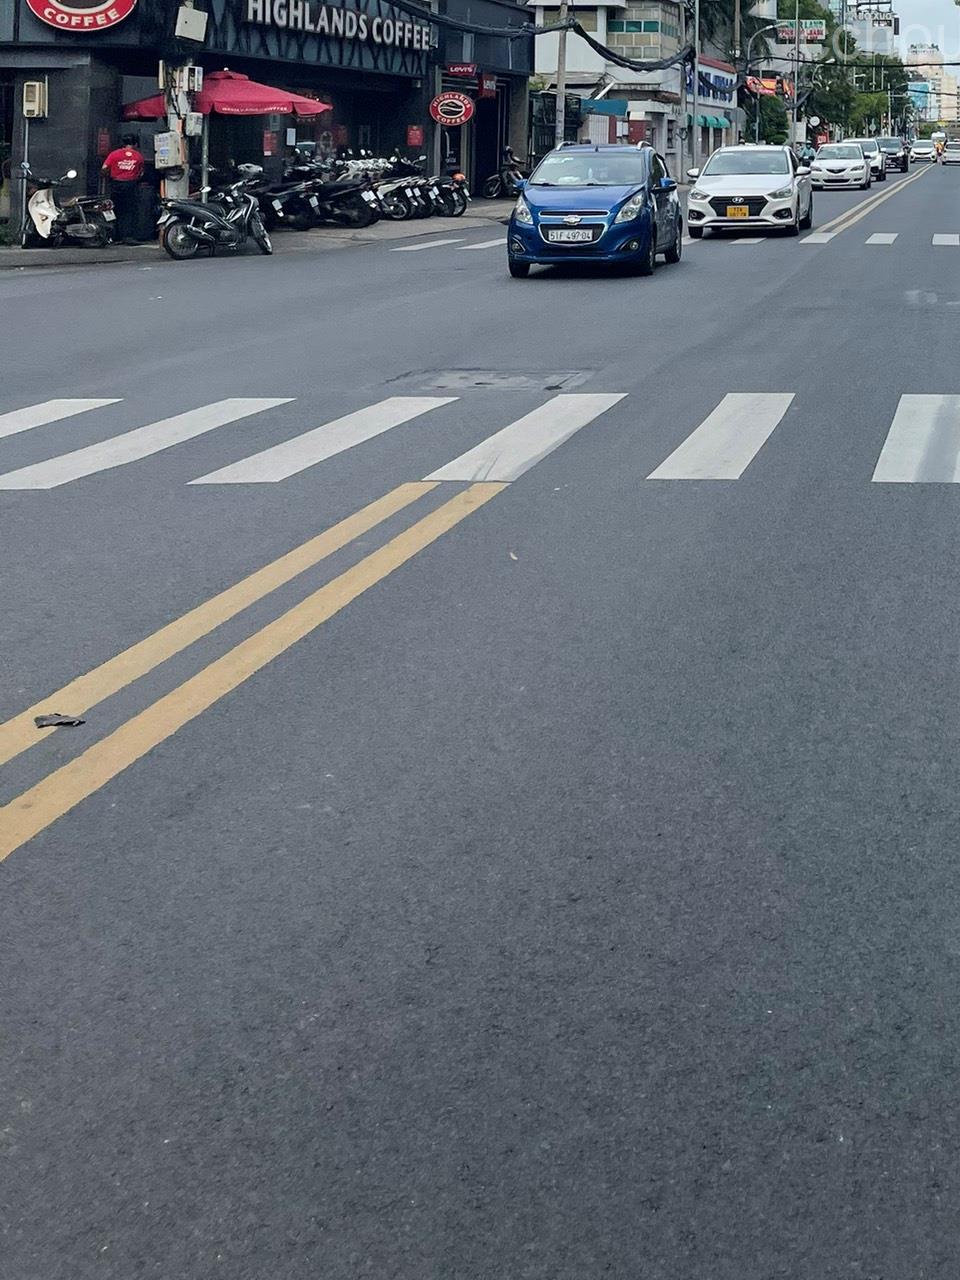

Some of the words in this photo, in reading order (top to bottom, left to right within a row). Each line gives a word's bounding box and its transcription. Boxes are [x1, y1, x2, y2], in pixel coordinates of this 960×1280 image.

[43, 7, 120, 27] COFFEE
[372, 17, 431, 51] COFFEE
[432, 93, 471, 108] HIGHLANDS
[436, 115, 466, 124] COFFEE
